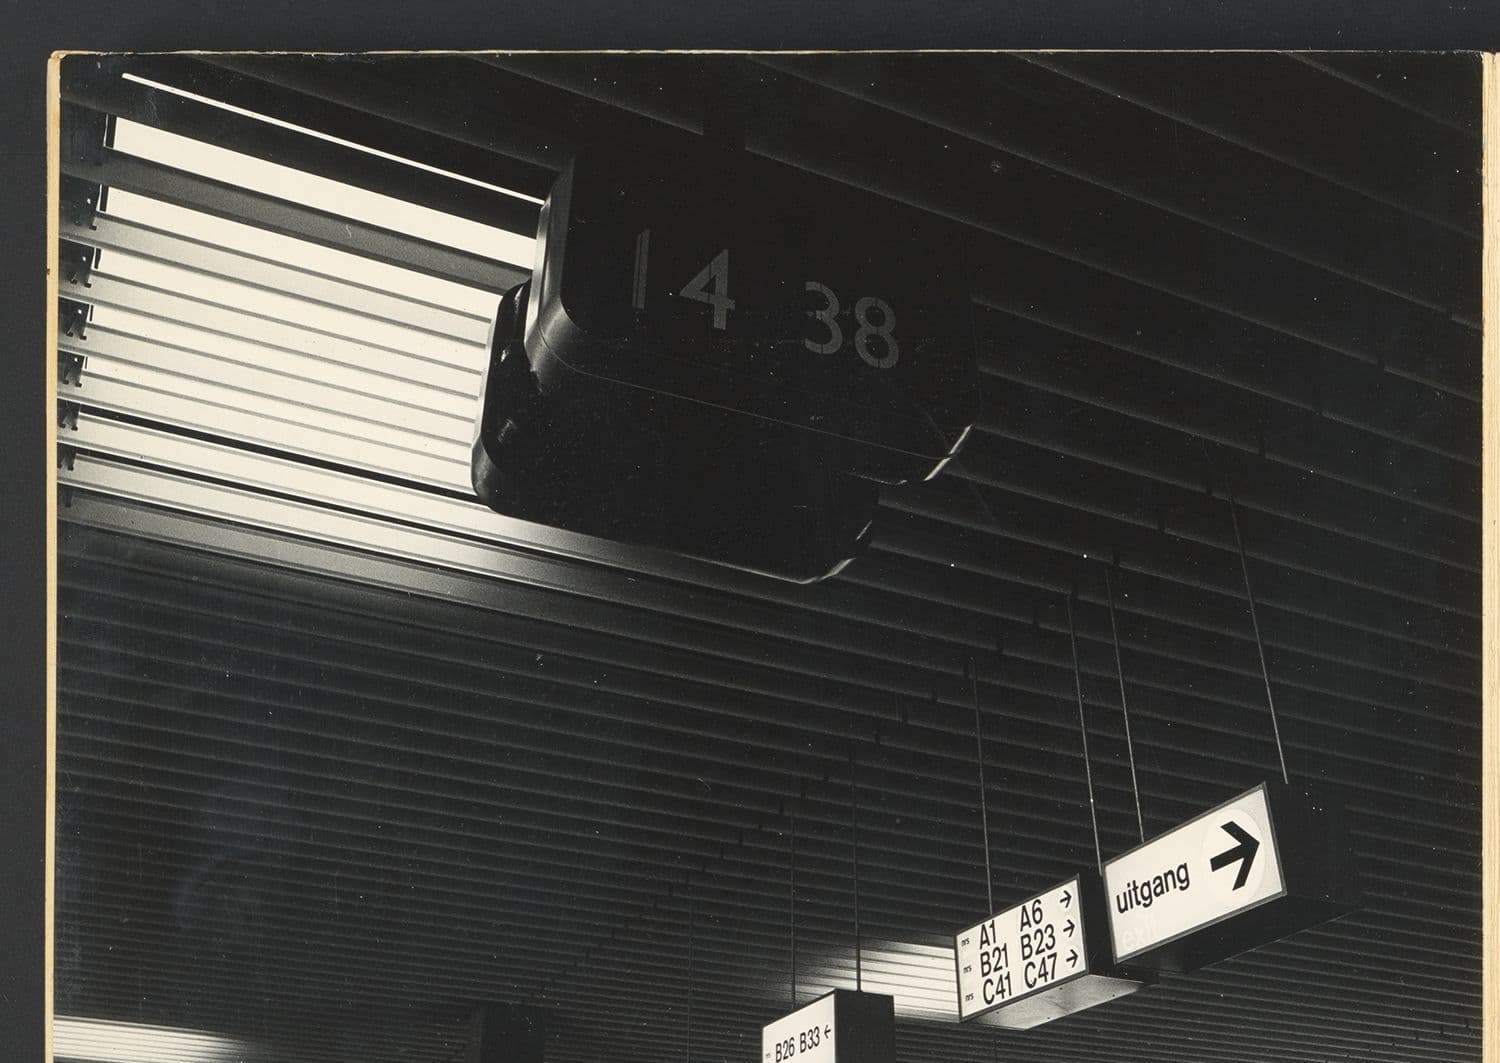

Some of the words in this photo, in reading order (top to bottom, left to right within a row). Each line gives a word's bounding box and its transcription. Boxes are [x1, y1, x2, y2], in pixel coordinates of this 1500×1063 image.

[632, 228, 736, 331] 14
[804, 280, 901, 369] 38
[1116, 862, 1190, 914] uitgang
[980, 920, 997, 949] A1
[1020, 899, 1043, 932] A6
[980, 942, 1009, 978] B21
[1020, 923, 1056, 961] B23
[983, 971, 1012, 1005] C41
[1024, 952, 1058, 989] C47
[775, 1036, 795, 1063] B26
[799, 1026, 820, 1054] B33
